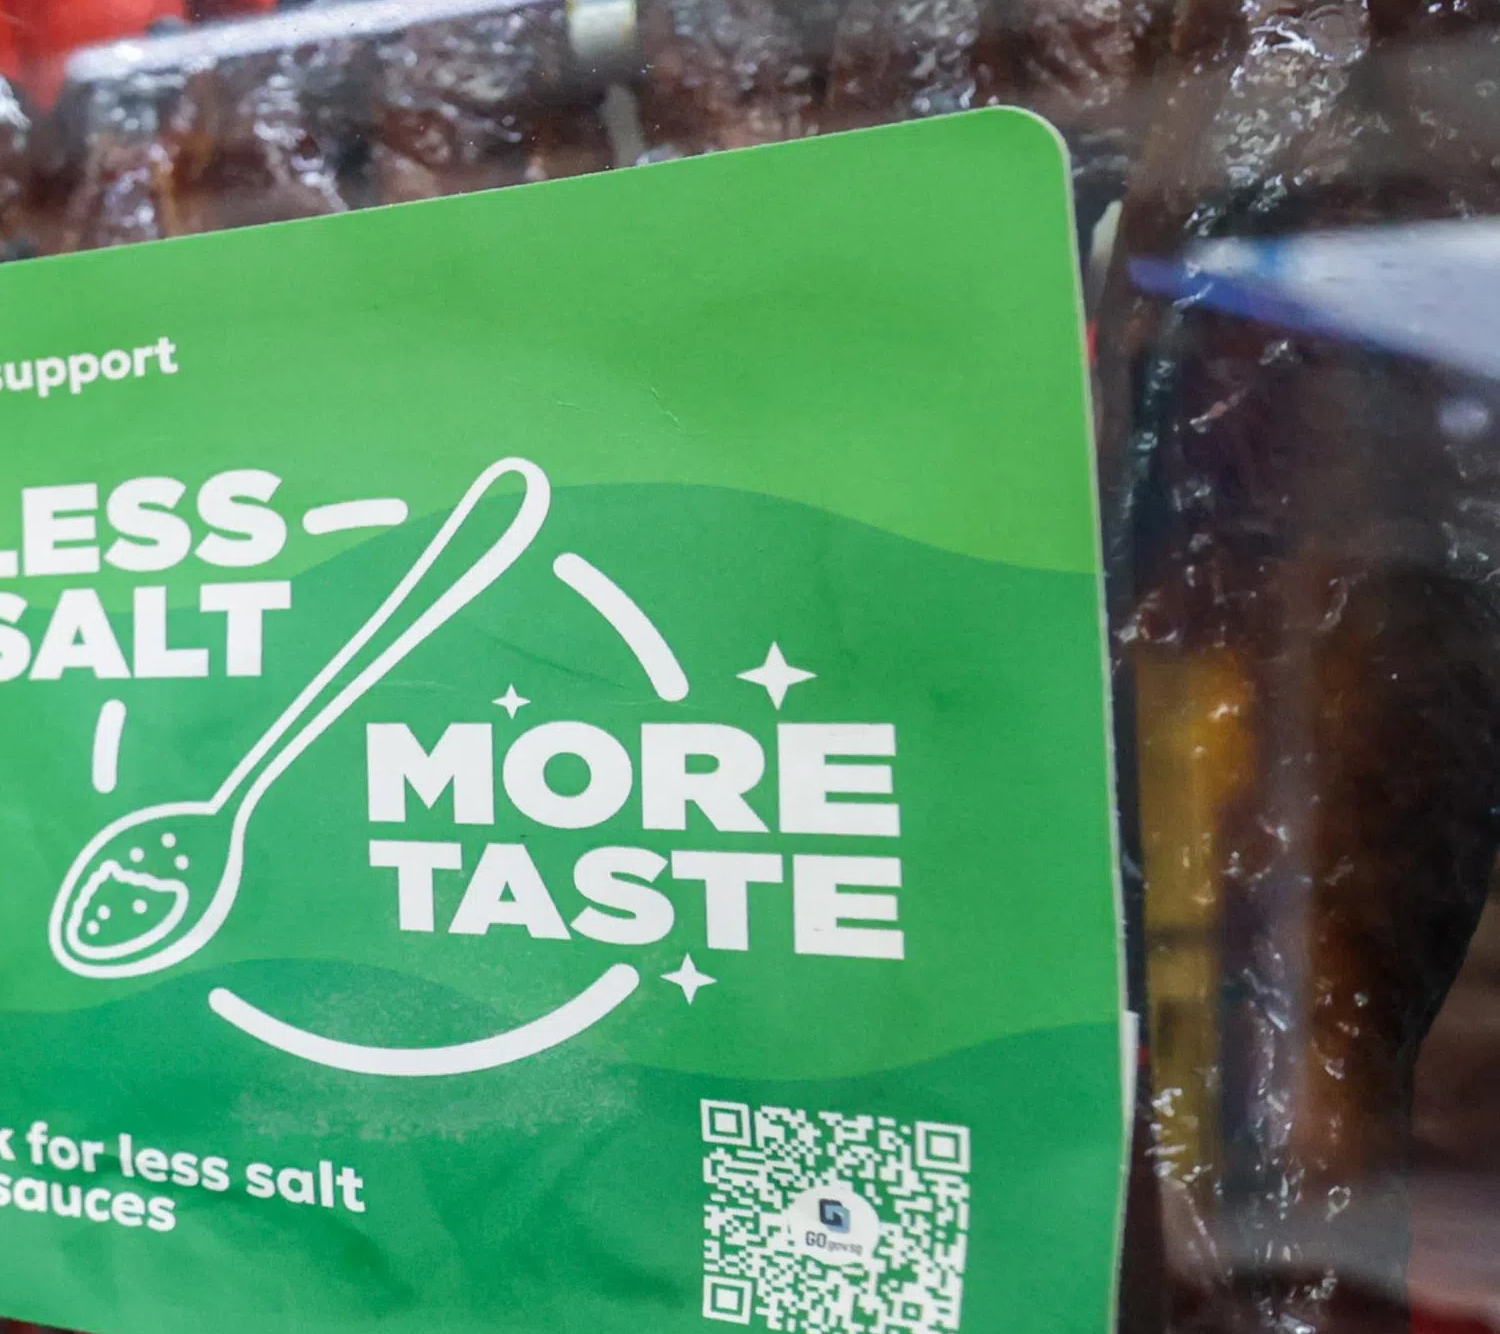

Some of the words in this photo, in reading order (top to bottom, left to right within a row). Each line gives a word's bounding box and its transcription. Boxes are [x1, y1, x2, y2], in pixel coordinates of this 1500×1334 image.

[366, 720, 900, 837] MORE
[369, 839, 905, 959] TASTE
[25, 1121, 104, 1172] for
[118, 1132, 231, 1192] less
[246, 1160, 366, 1213] salt
